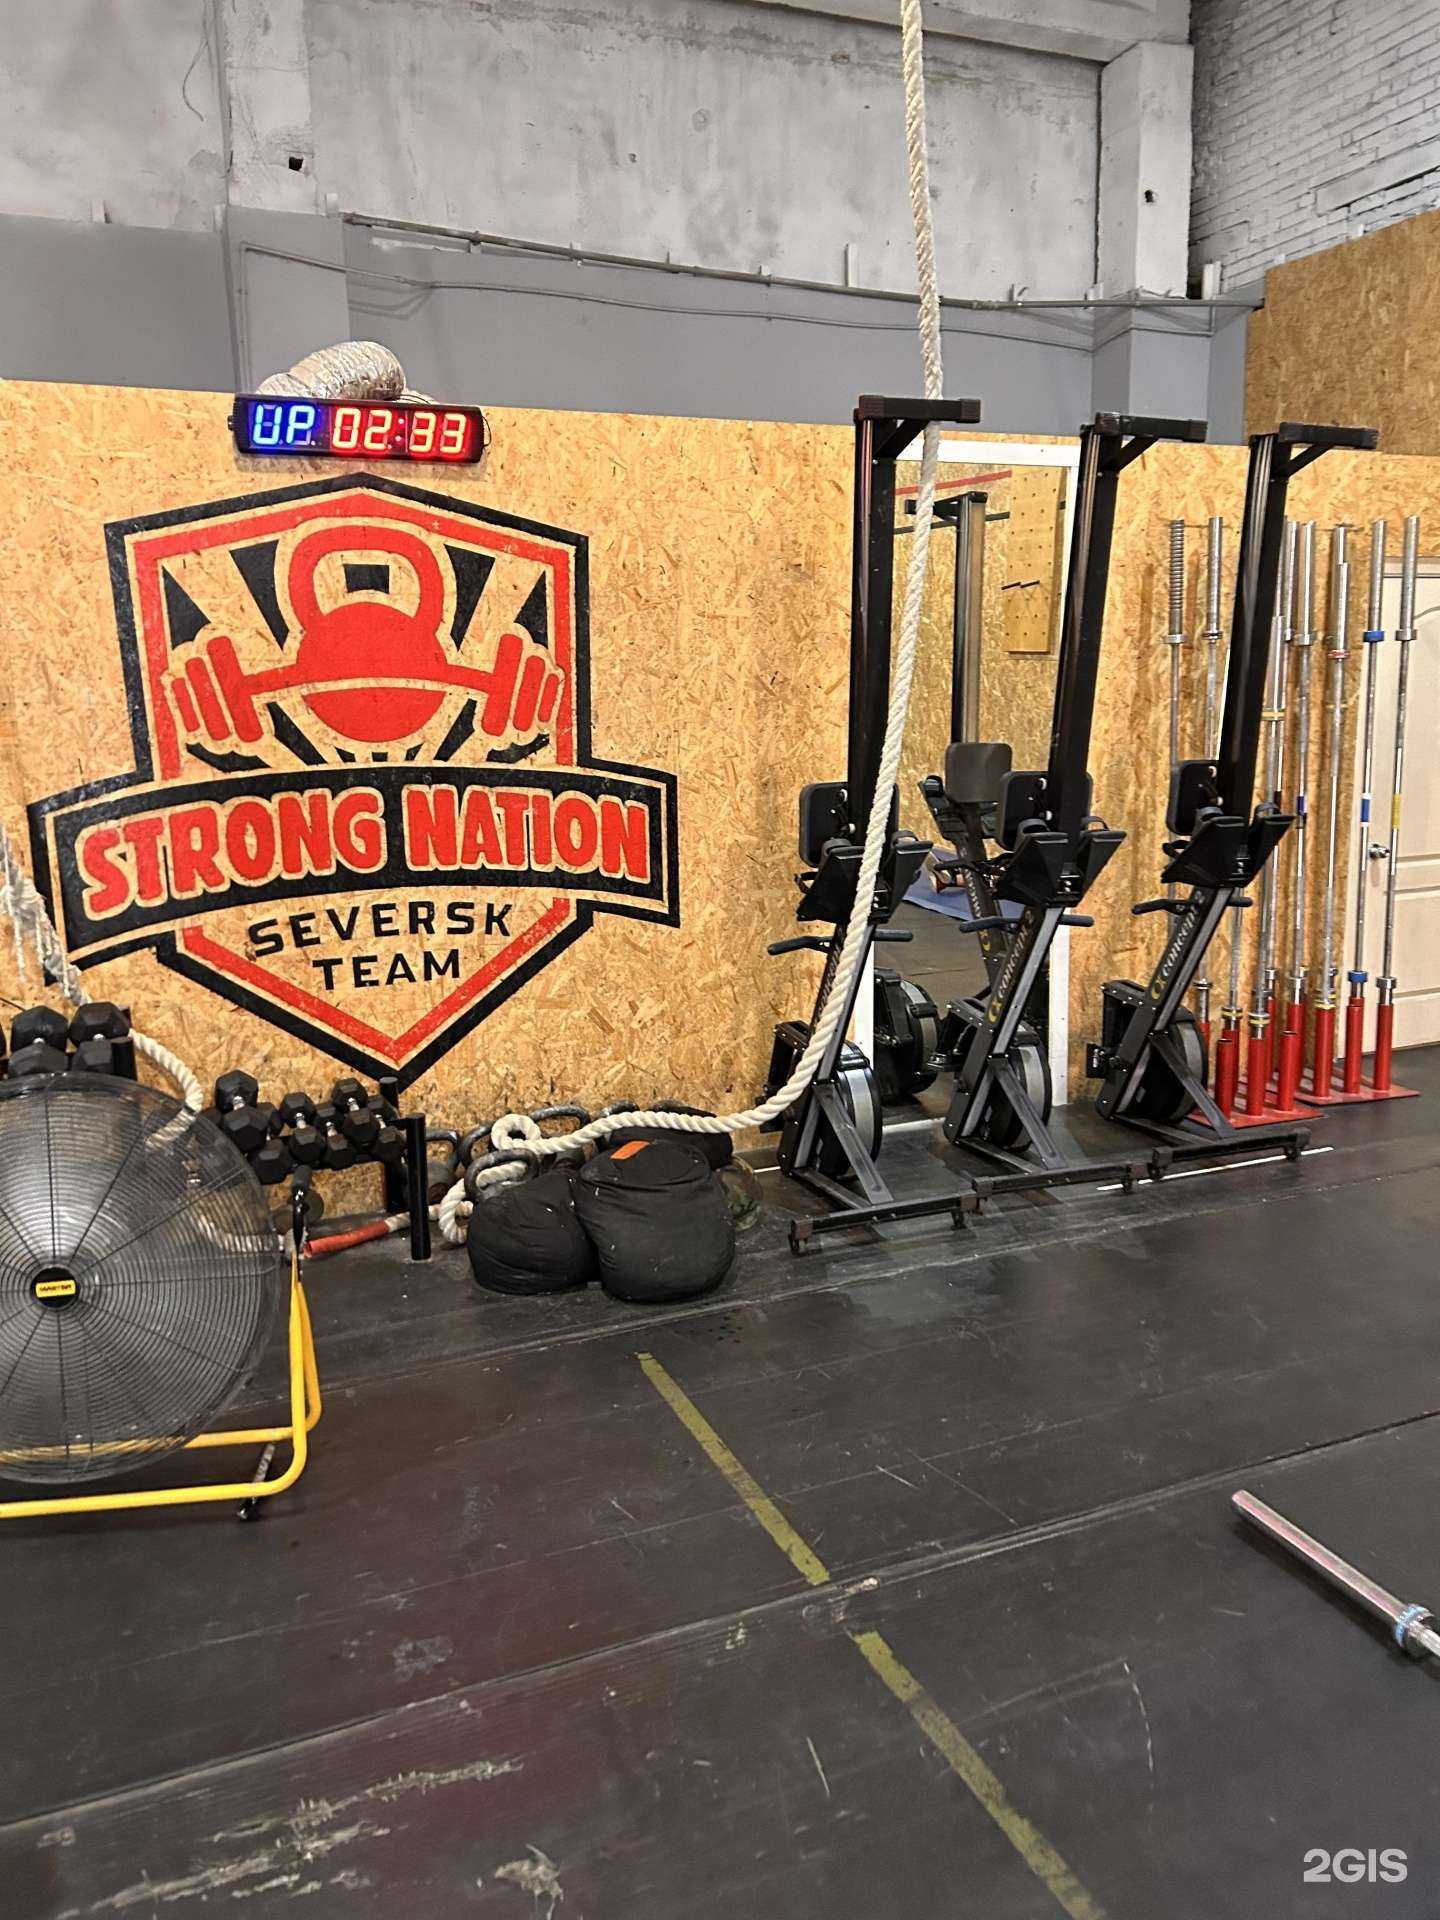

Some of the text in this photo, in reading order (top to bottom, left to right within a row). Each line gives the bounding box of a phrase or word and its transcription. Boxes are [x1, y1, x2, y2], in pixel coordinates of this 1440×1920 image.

[252, 404, 467, 453] UP 02:33
[78, 786, 651, 918] STRONG NATION
[249, 901, 513, 957] SEVERSK
[312, 948, 460, 991] TEAM
